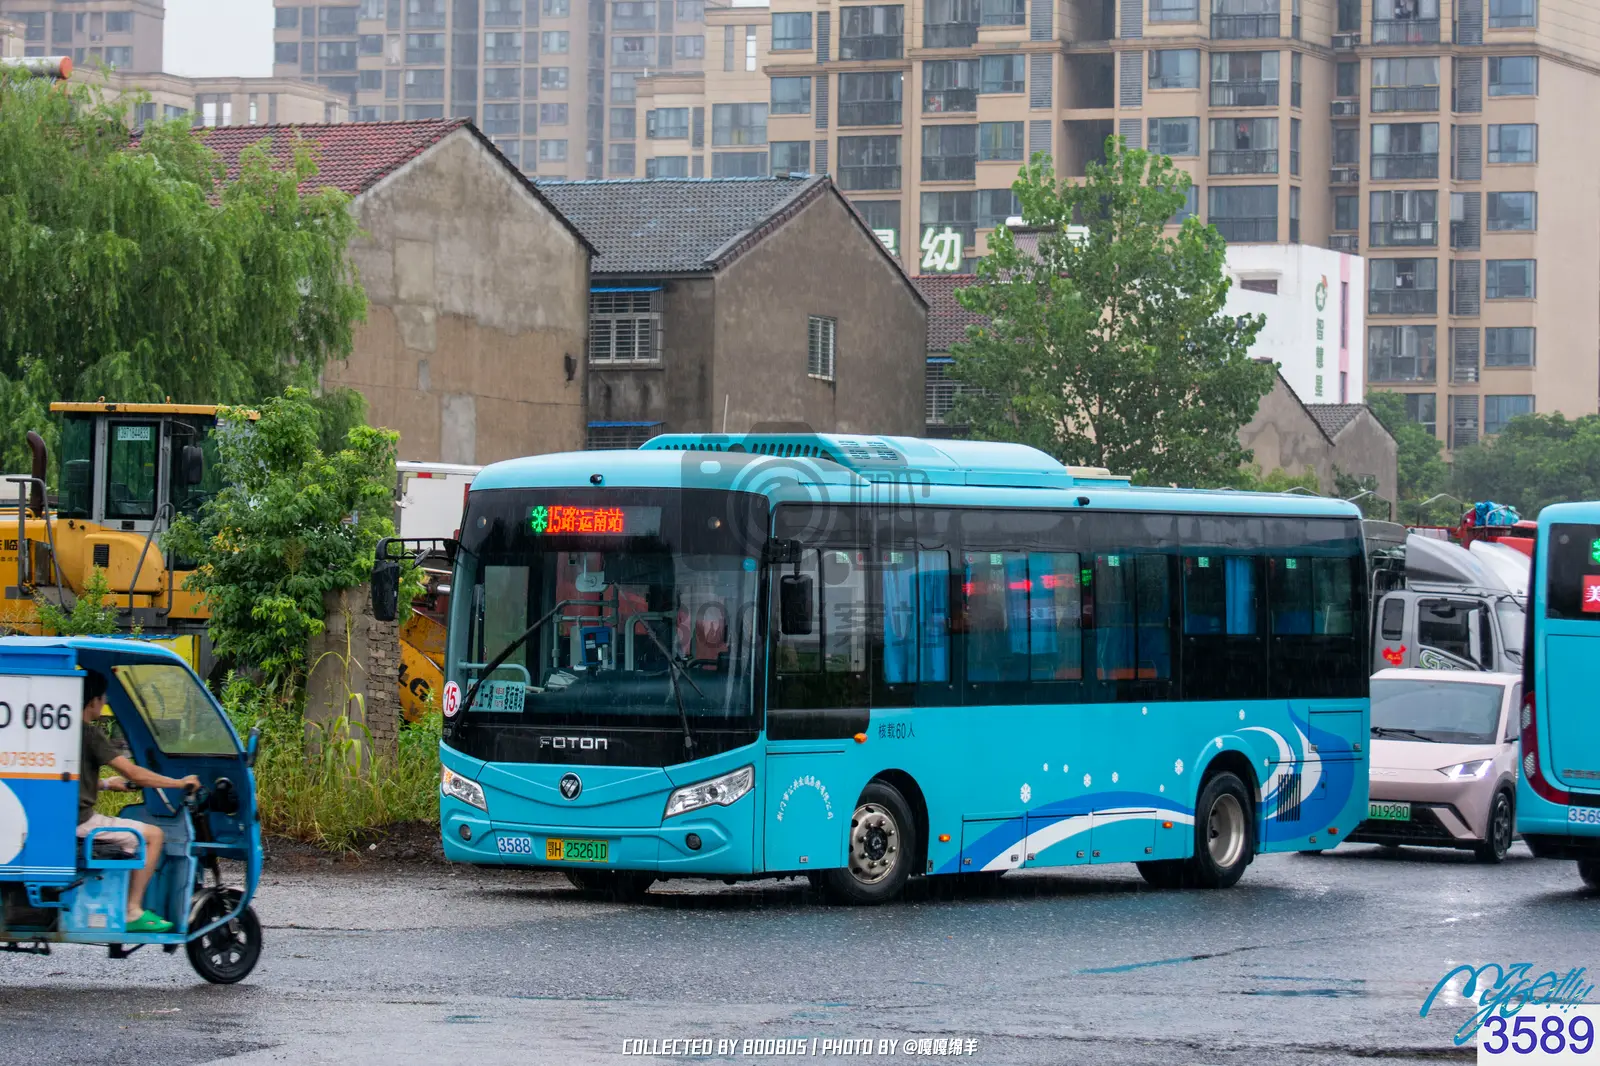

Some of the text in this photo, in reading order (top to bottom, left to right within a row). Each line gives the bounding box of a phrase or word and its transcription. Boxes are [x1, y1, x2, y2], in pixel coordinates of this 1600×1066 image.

[546, 506, 624, 533] 15路运南站
[446, 685, 457, 712] 15
[24, 703, 72, 730] 066
[878, 722, 915, 740] 核载60人
[540, 736, 608, 750] FOTON
[1370, 804, 1409, 819] D19280
[498, 837, 531, 853] 3588
[566, 842, 607, 859] 25261D
